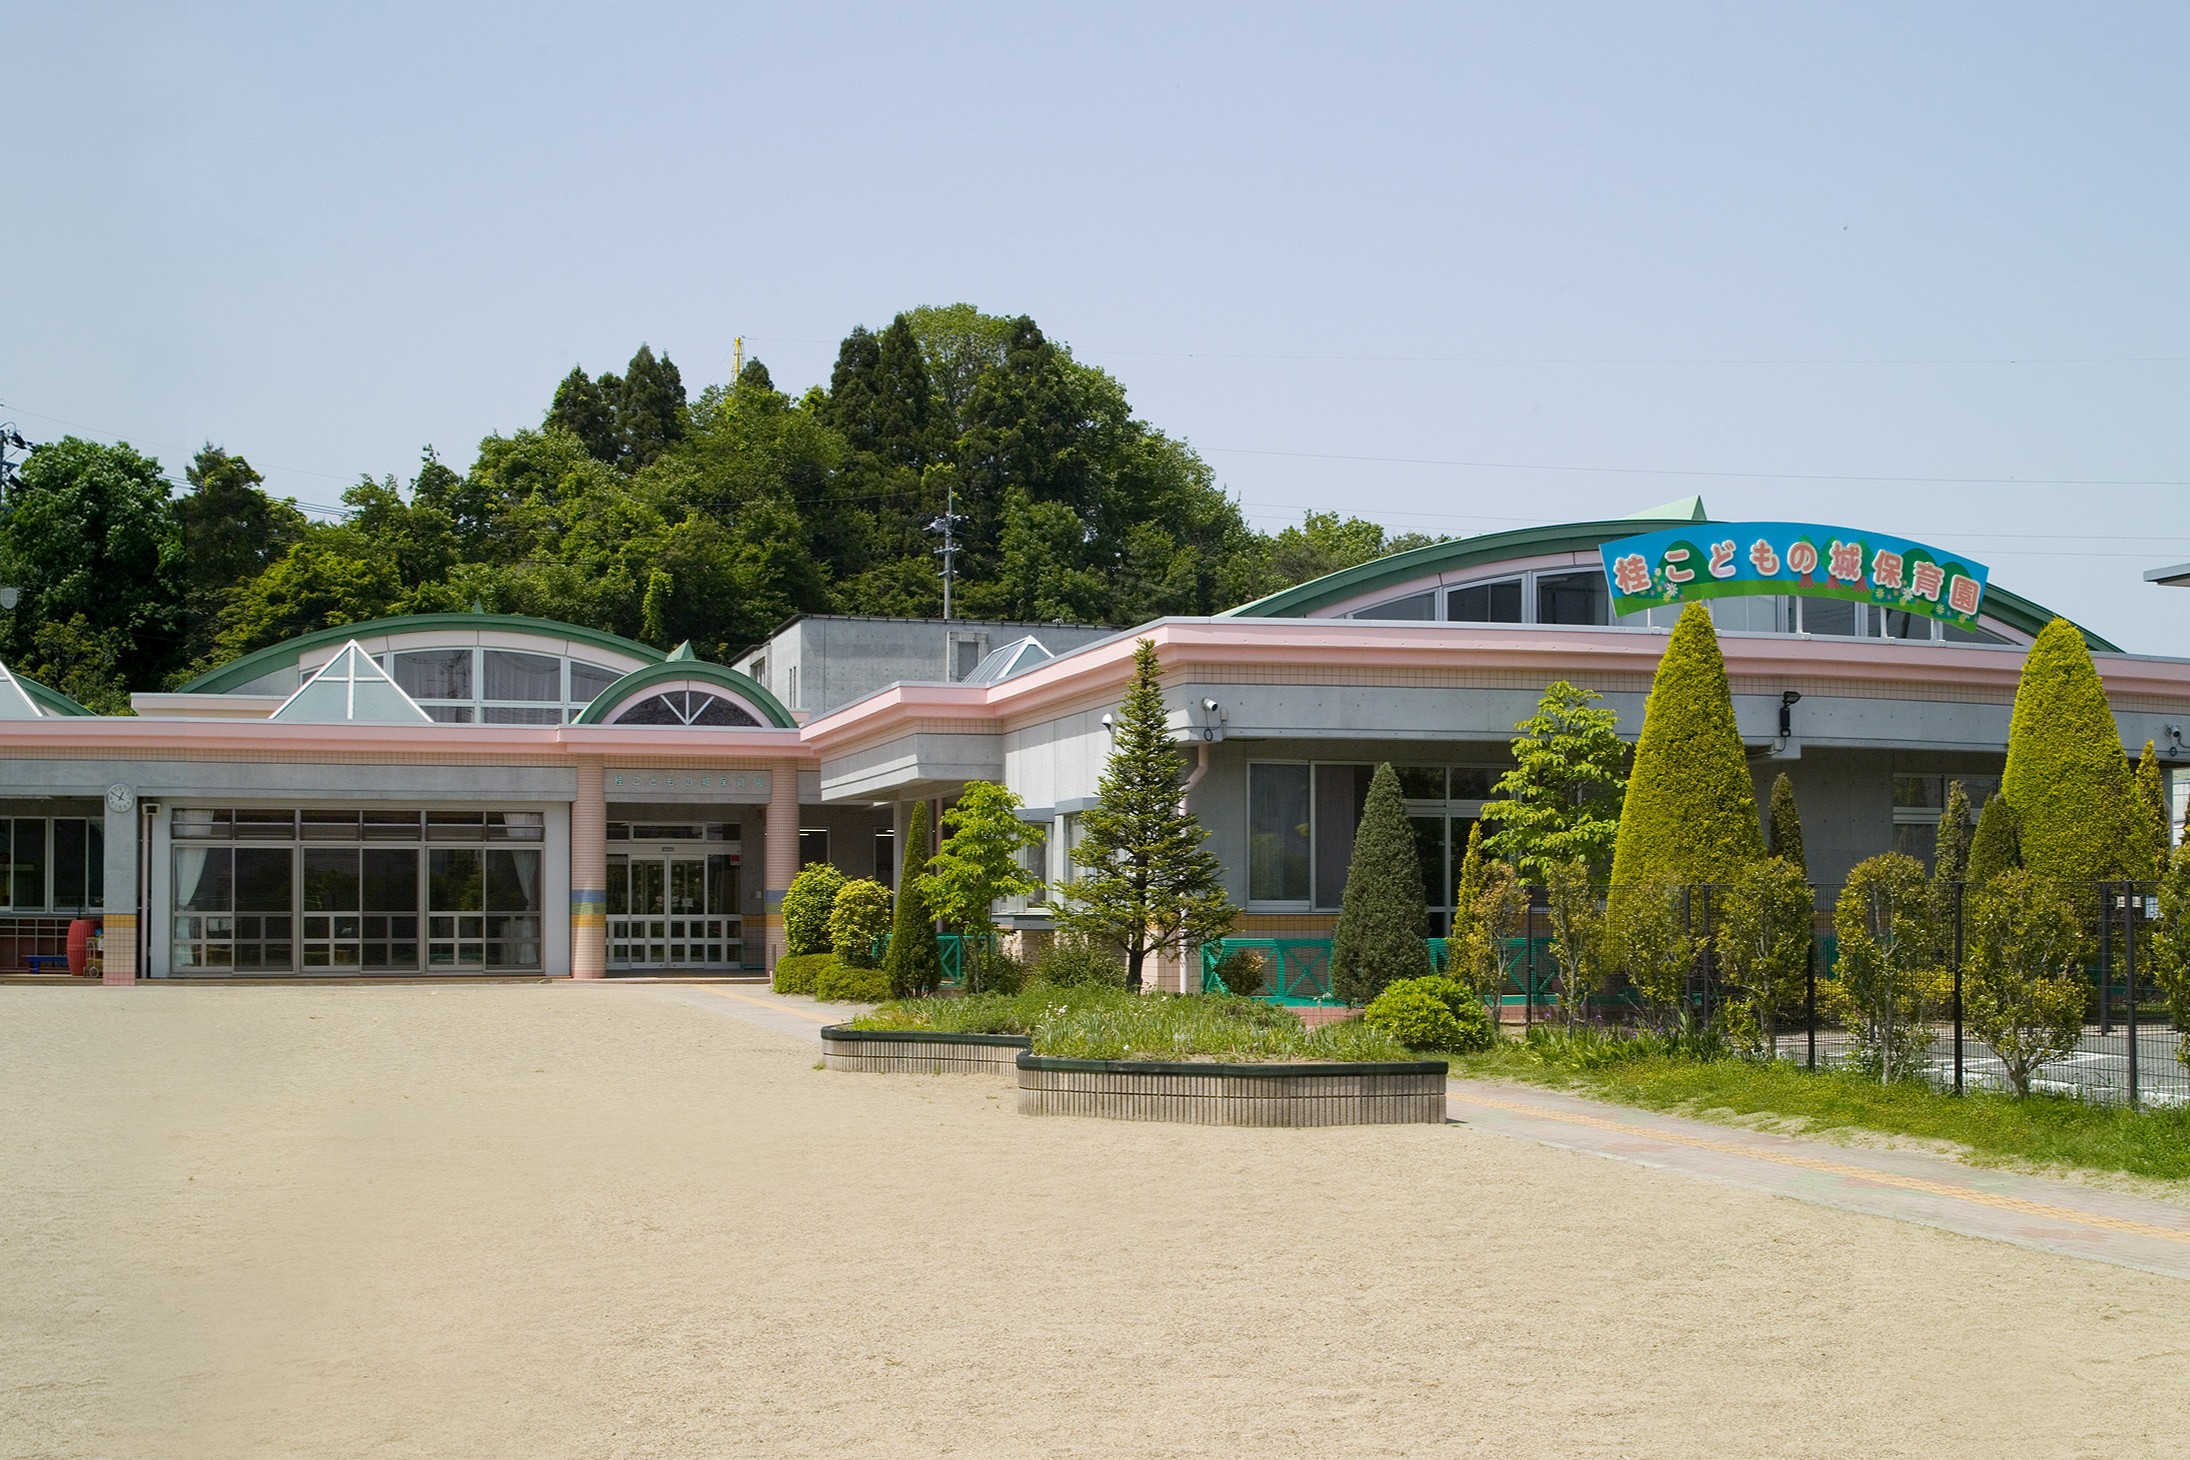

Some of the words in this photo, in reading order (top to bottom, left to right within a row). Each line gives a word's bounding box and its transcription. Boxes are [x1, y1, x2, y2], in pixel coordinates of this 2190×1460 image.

[1615, 539, 1981, 616] 桂こどもの城保育園
